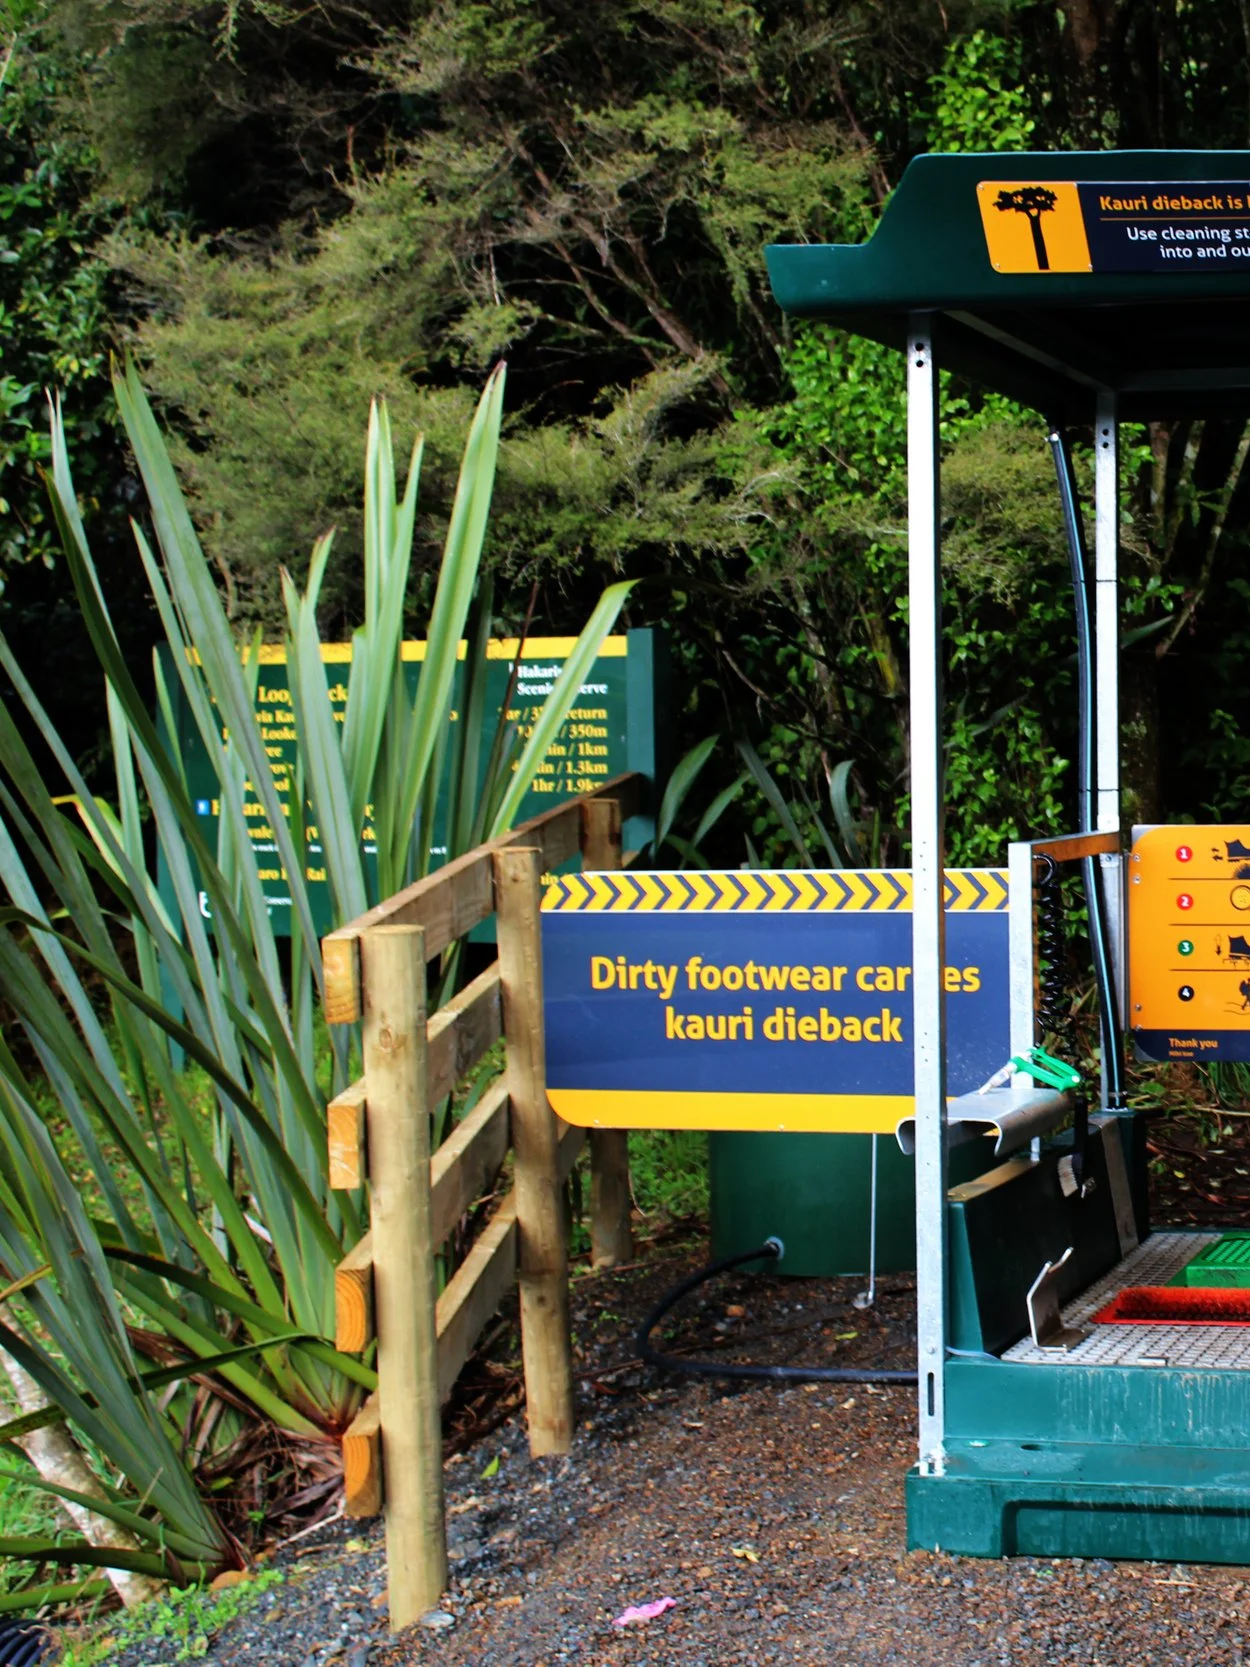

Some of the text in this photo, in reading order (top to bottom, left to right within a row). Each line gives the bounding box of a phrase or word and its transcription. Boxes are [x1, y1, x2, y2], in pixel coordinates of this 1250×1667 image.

[1100, 196, 1148, 210] Kauri
[1152, 195, 1223, 210] dieback
[1227, 195, 1243, 209] is
[1126, 226, 1157, 240] Use
[1161, 226, 1231, 243] cleaning
[1160, 245, 1192, 258] into
[1197, 244, 1227, 257] and
[569, 724, 608, 738] 350m
[578, 742, 608, 756] 1km
[532, 778, 556, 793] 1hr
[591, 955, 981, 1000] Dirty footwear cares
[665, 1006, 904, 1042] kauri dieback
[1168, 1038, 1219, 1050] Thank you
